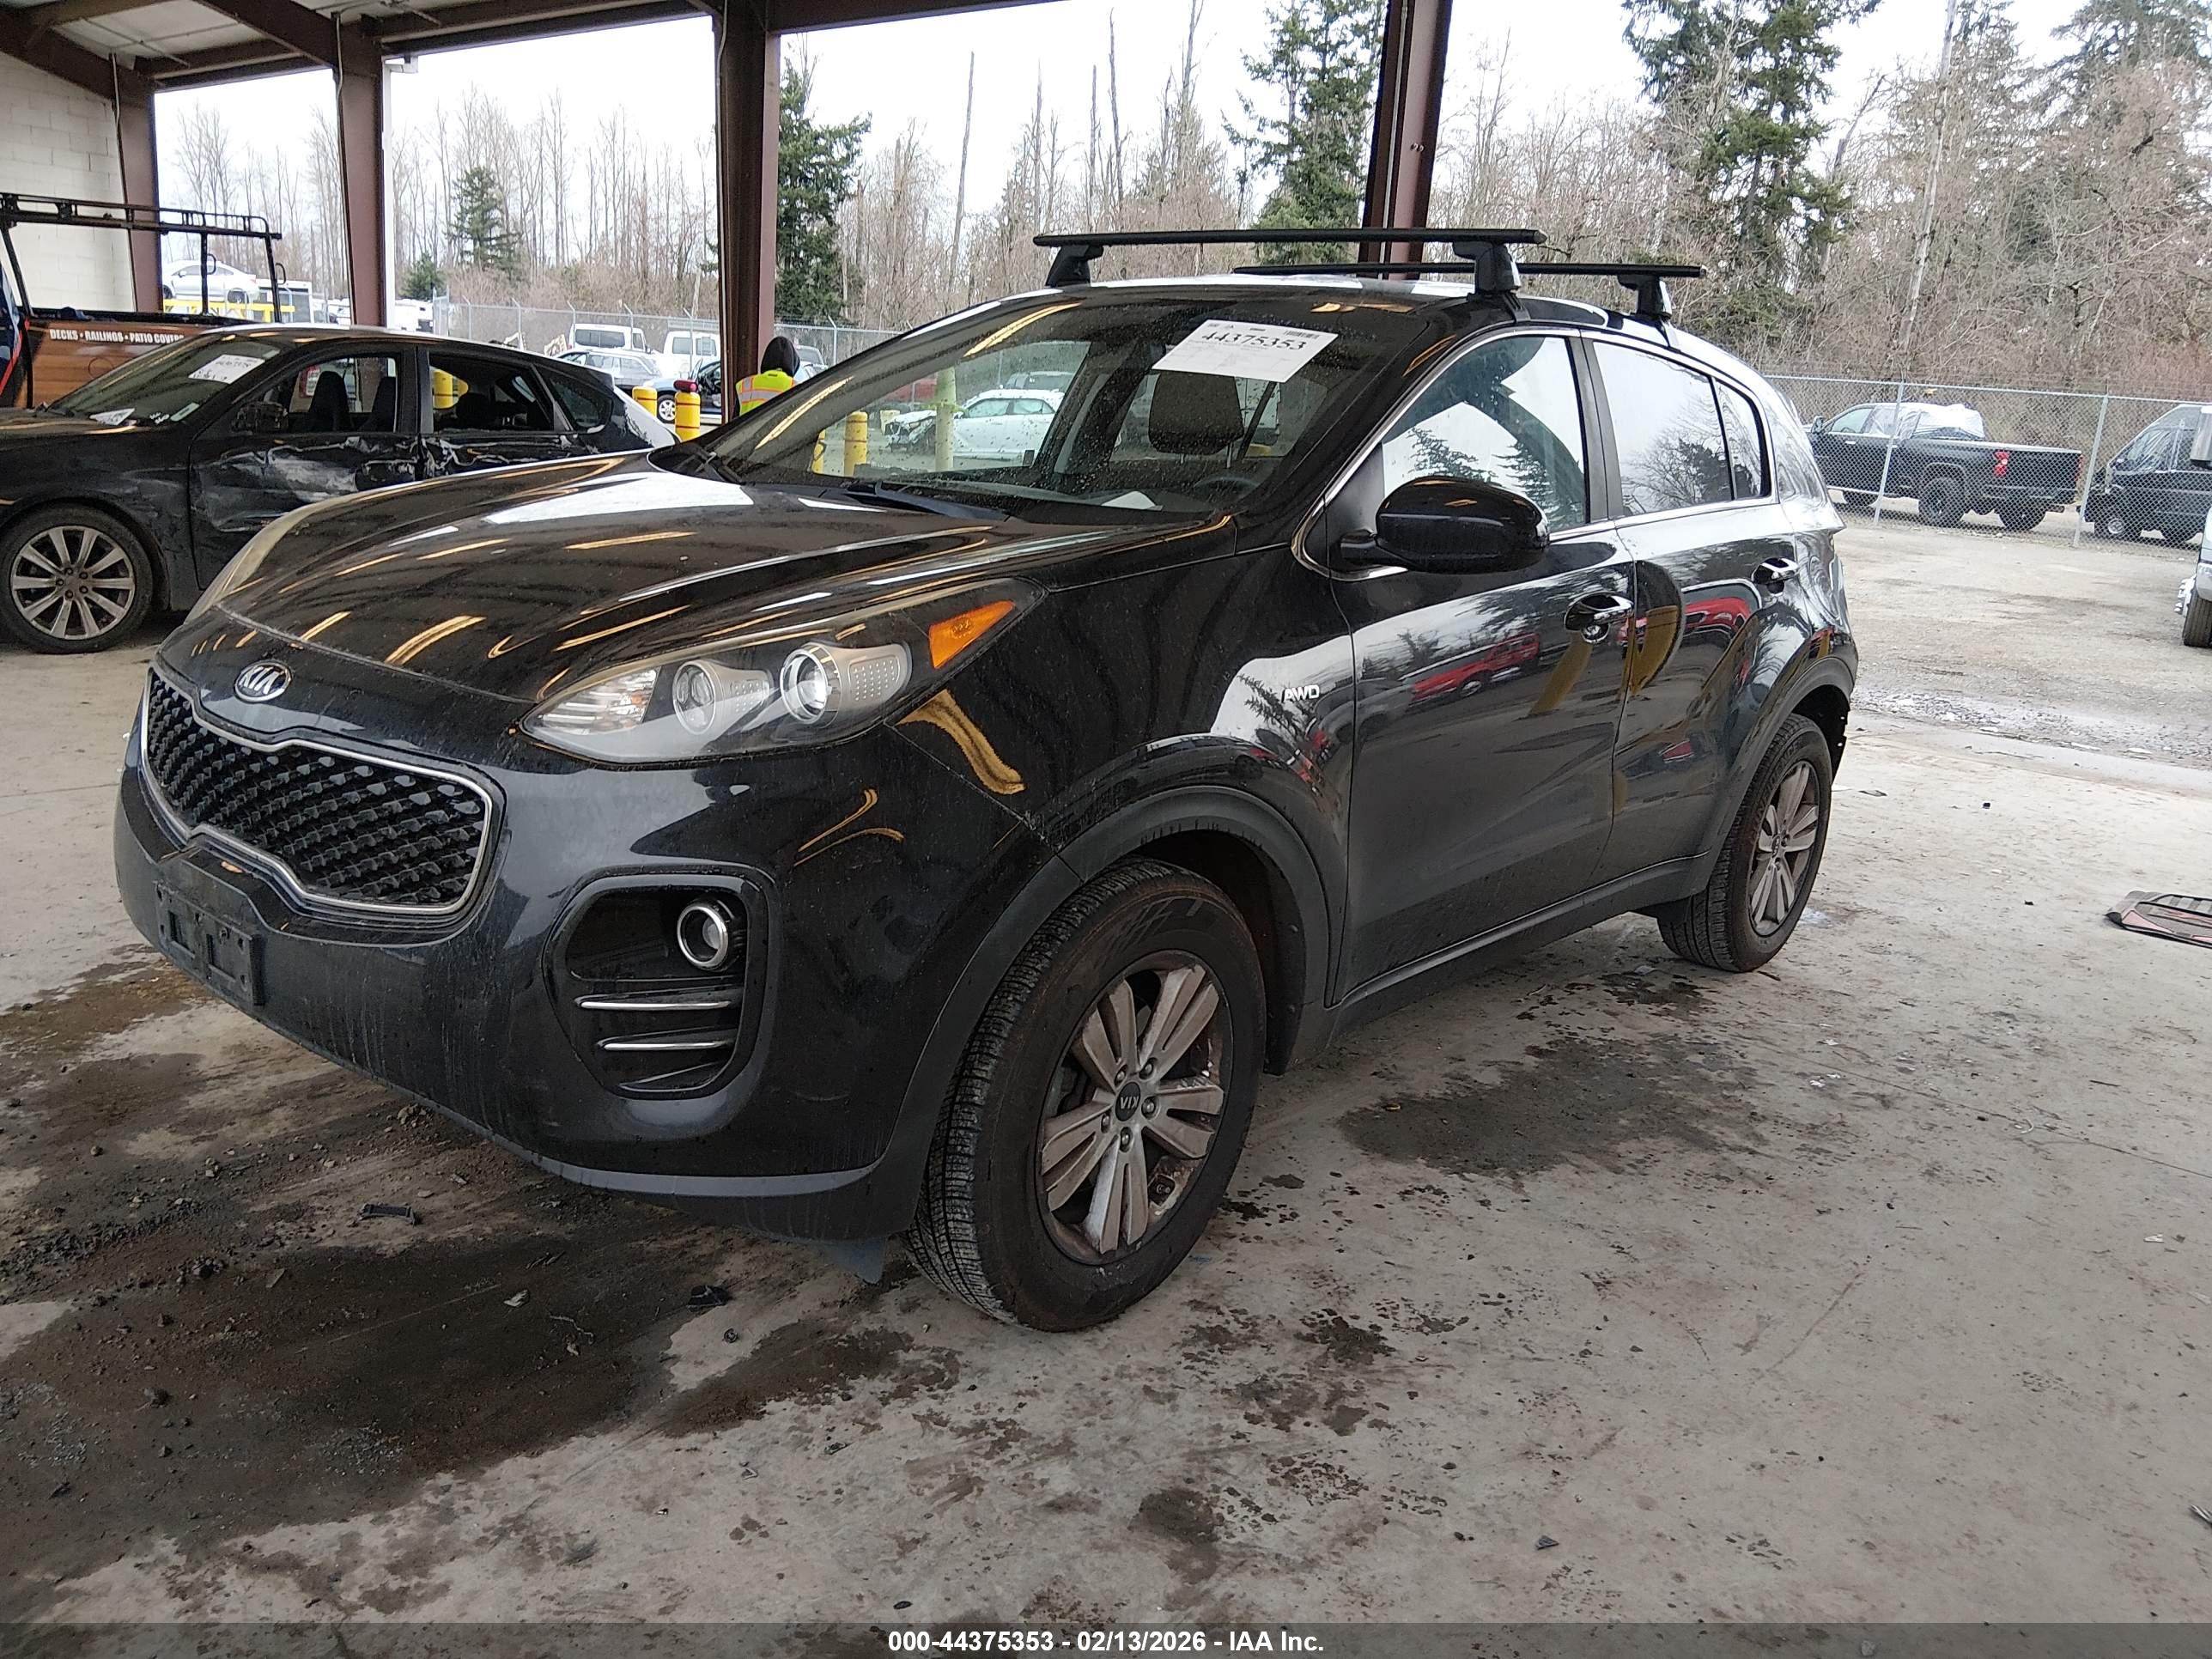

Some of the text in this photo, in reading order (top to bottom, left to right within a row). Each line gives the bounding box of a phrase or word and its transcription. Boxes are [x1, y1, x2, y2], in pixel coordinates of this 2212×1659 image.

[49, 329, 79, 341] DECKS
[85, 331, 125, 343] RAILINGS
[129, 331, 154, 343] PATIO
[1202, 331, 1306, 350] 44375353
[238, 665, 286, 696] KIA
[1283, 685, 1320, 702] AWD
